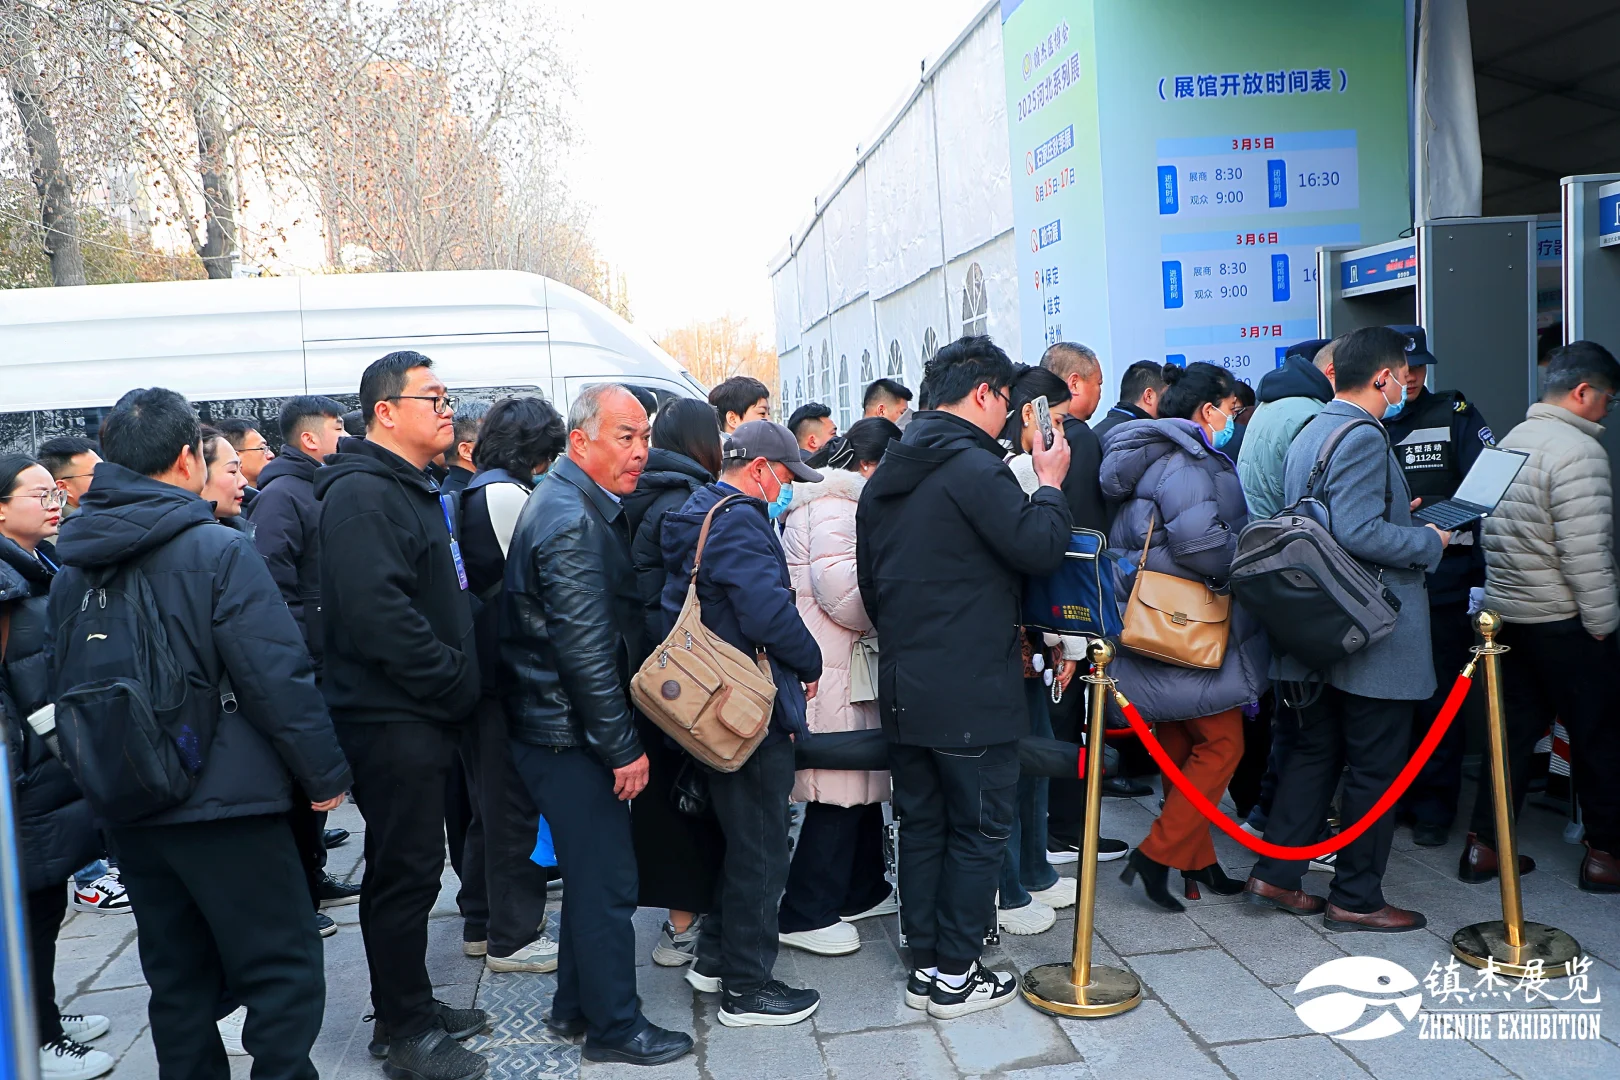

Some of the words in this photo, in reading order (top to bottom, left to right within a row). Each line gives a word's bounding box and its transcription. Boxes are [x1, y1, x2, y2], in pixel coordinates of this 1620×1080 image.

[1018, 51, 1080, 122] 2025河北系列展
[1231, 136, 1275, 151] 3月5日
[1188, 171, 1208, 182] 展商
[1215, 167, 1243, 181] 8:30
[1298, 171, 1340, 188] 16:30
[1164, 174, 1174, 205] 进馆时间
[1190, 195, 1209, 206] 观众
[1216, 191, 1244, 204] 9:00
[1236, 231, 1279, 246] 3月6日
[1045, 266, 1059, 288] 保定
[1193, 266, 1212, 277] 展商
[1219, 262, 1247, 275] 8:30
[1194, 289, 1213, 300] 观众
[1220, 285, 1248, 298] 9:00
[1240, 325, 1282, 338] 3月7日
[1223, 355, 1251, 368] 8:30
[1405, 443, 1442, 455] 大型活动
[1415, 453, 1442, 463] 11242
